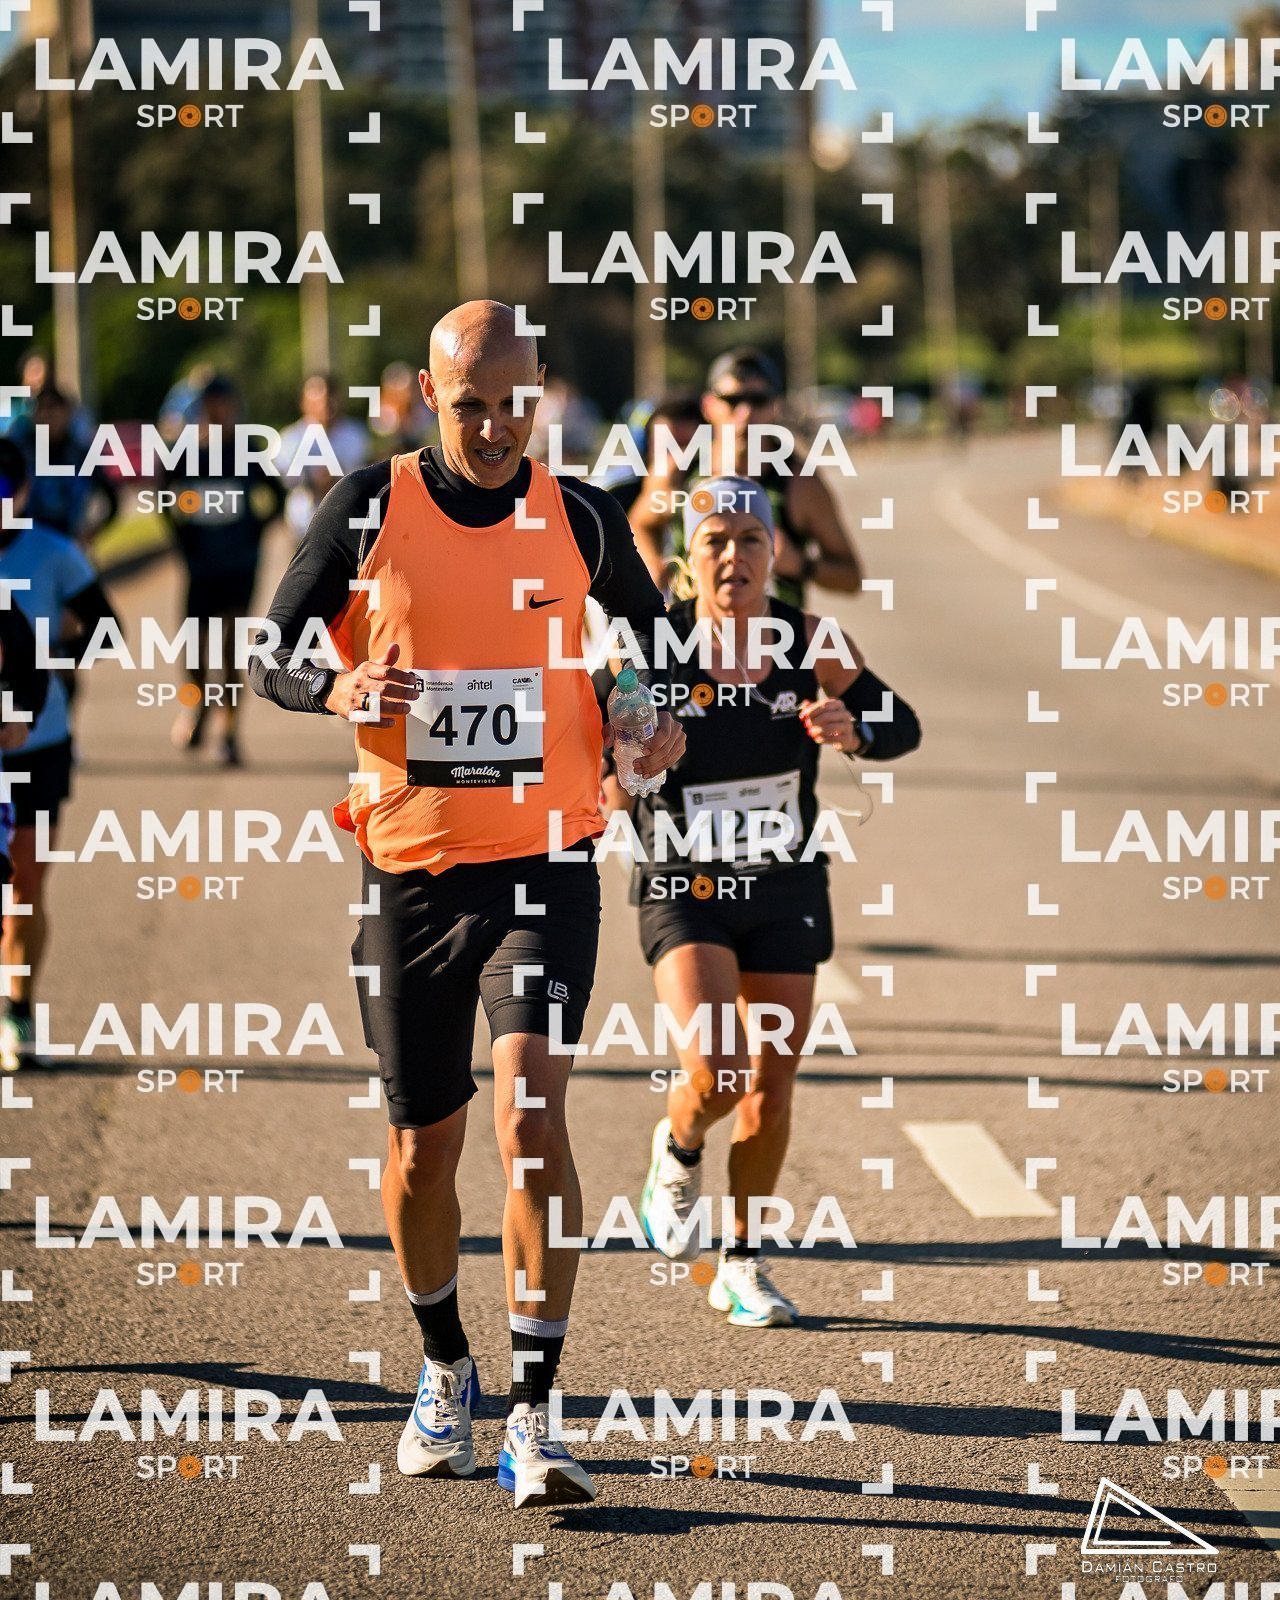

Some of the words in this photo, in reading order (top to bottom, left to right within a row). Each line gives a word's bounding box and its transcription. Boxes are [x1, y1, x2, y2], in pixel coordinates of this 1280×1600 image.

[467, 679, 493, 691] antel
[429, 704, 518, 746] 470
[450, 765, 501, 778] Maratón
